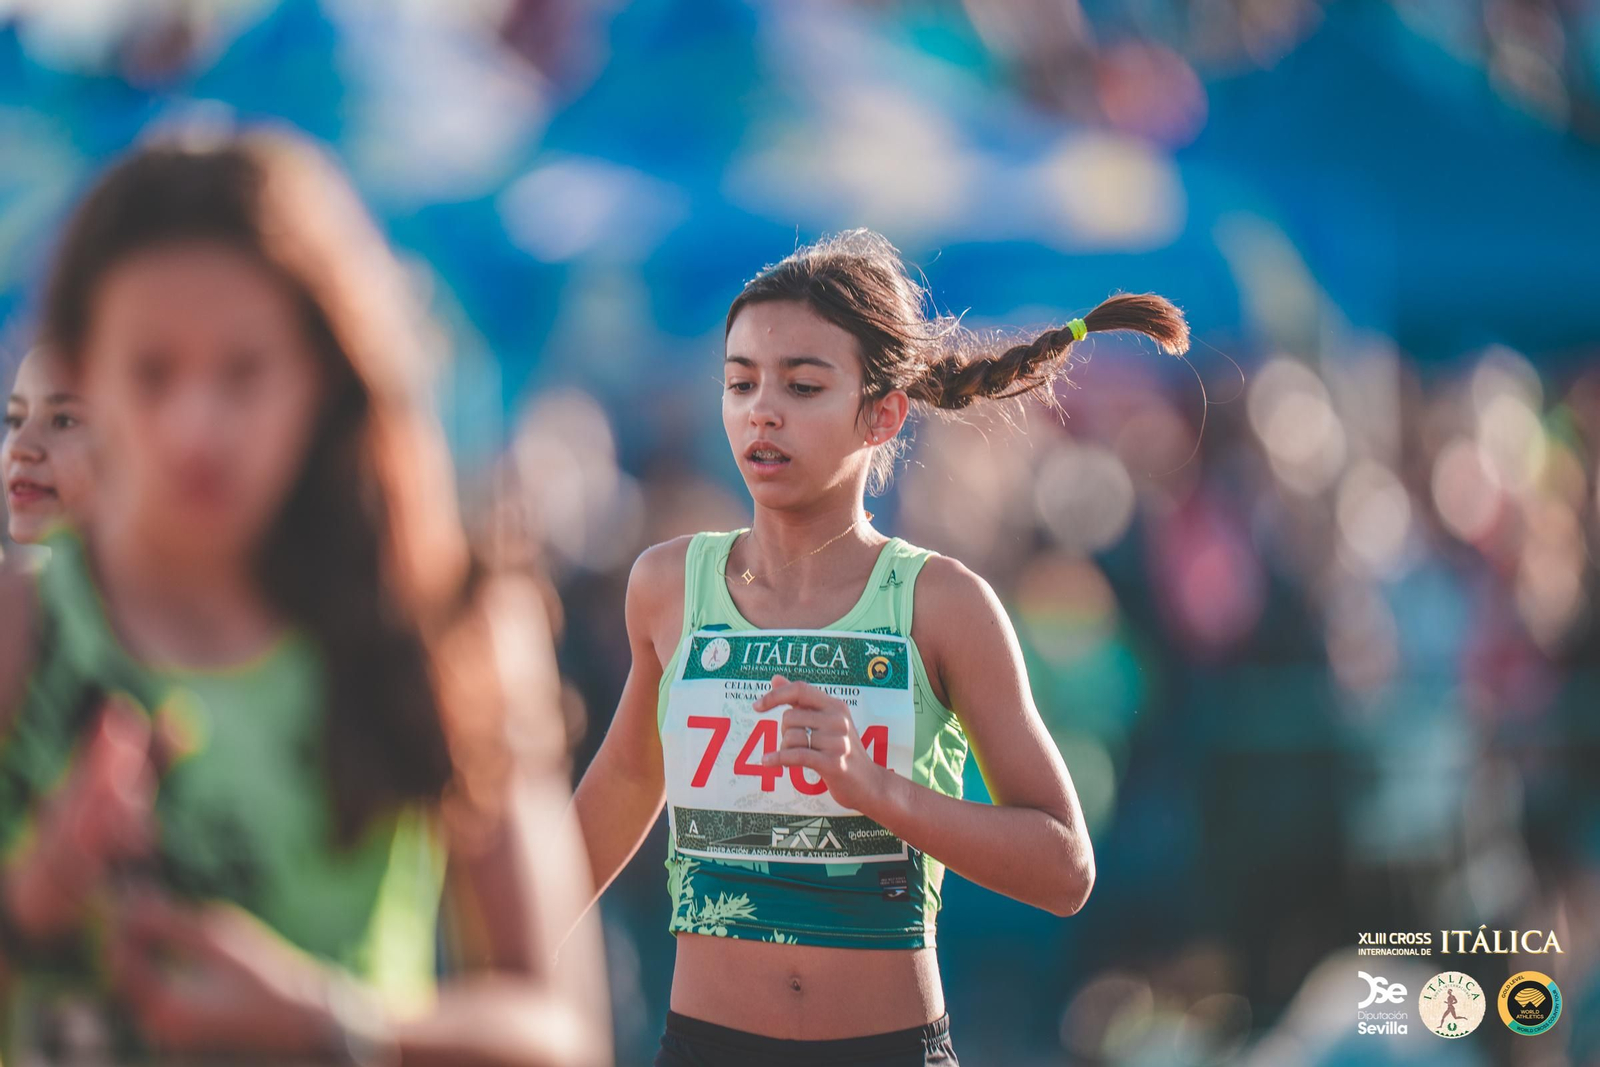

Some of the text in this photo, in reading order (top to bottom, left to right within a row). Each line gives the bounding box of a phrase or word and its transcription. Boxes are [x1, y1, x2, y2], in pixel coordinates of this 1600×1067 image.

[741, 637, 849, 669] ITÁLICA
[740, 664, 850, 676] INTERNATIONAL CROSS COUNTRY
[724, 681, 752, 691] CELIA
[724, 692, 758, 701] UNICAJA
[706, 845, 749, 855] FEDERACIÓN
[751, 848, 792, 857] ANDALUZA
